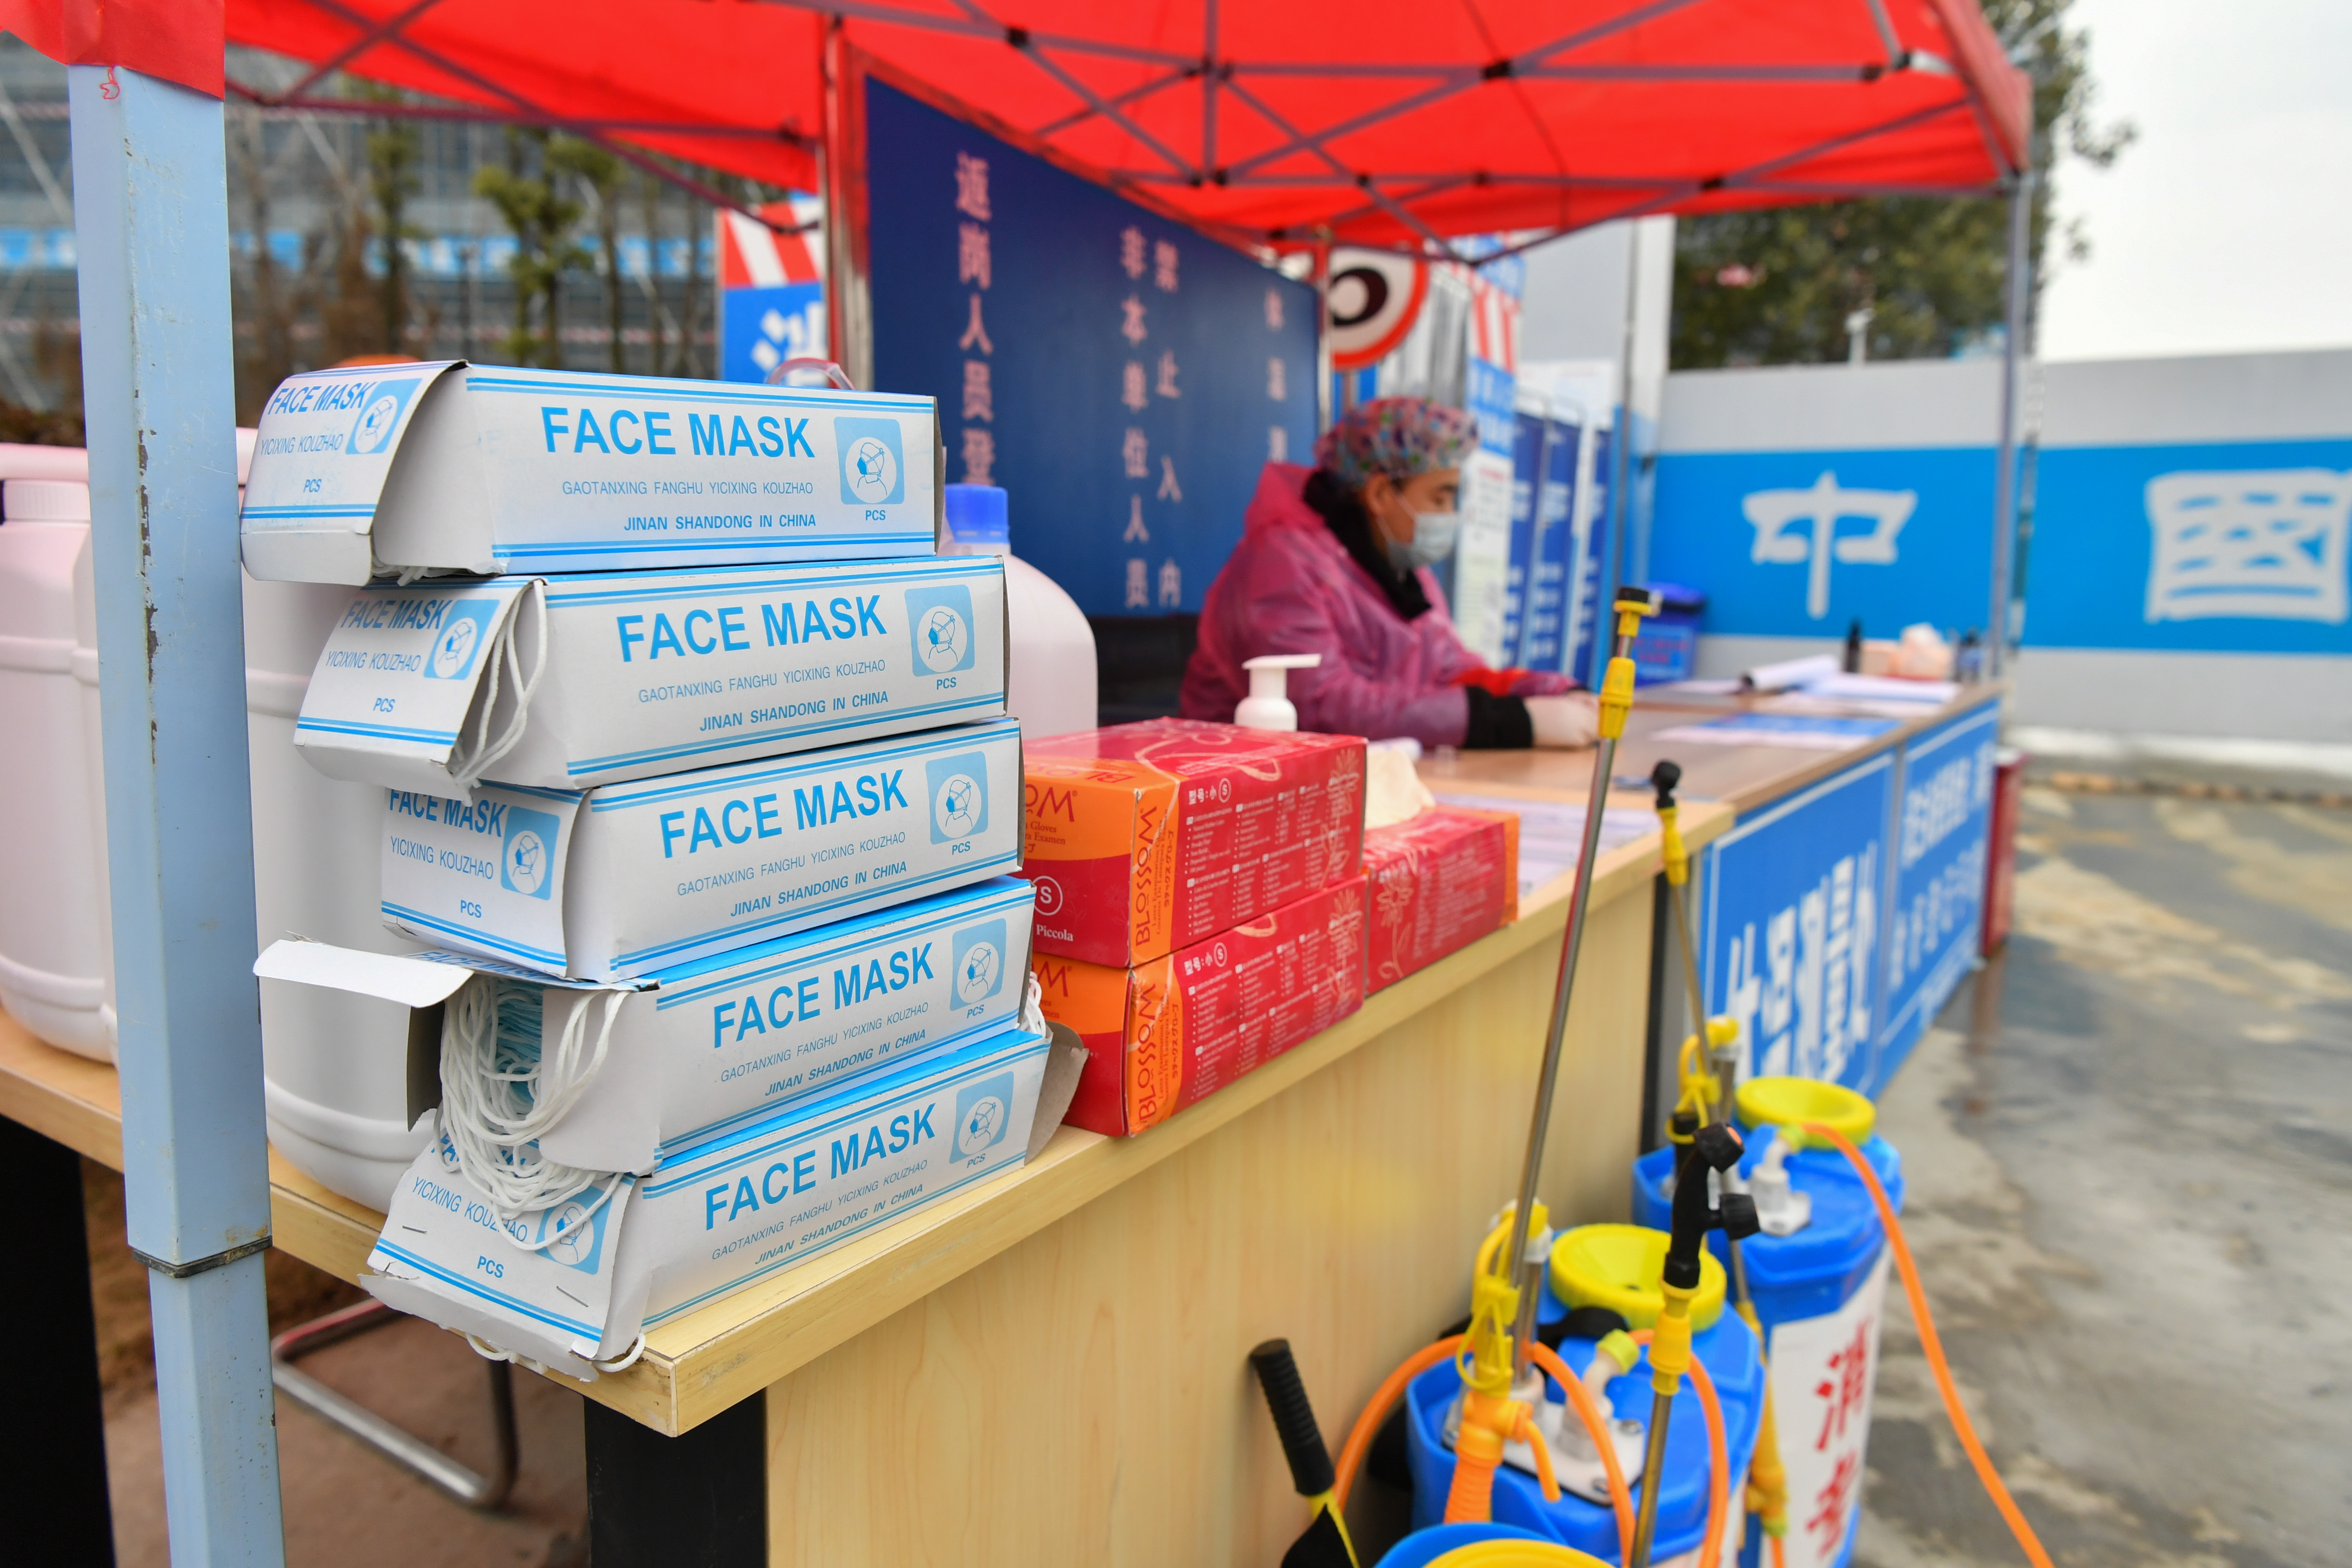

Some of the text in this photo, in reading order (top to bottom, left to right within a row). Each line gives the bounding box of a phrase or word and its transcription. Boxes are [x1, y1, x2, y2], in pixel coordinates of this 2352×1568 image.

[267, 382, 378, 415] FACE MASK
[261, 434, 343, 455] YICIXING KOUZHAO
[541, 406, 815, 458] FACE MASK
[303, 479, 322, 493] PCS
[562, 481, 813, 495] GAOTANXING FANGHU YICIXING KOUZHAO
[623, 514, 816, 531] JINAN SHANDONG IN CHINA
[865, 509, 886, 521] PCS
[340, 600, 453, 629] FACE MASK
[617, 595, 887, 662] FACE MASK
[326, 651, 421, 672] YICIXING KOUZHAO
[638, 659, 885, 704] GAOTANXING FANGHU YICIXING KOUZHAO
[936, 677, 957, 690] PCS
[373, 697, 395, 713] PCS
[700, 691, 889, 732] JINAN SHANDONG IN CHINA
[389, 789, 507, 838] FACE MASK
[659, 768, 909, 858] FACE MASK
[391, 836, 493, 879] YICIXING KOUZHAO
[677, 832, 906, 896] GAOTANXING FANGHU YICIXING KOUZHAO
[952, 841, 971, 855] PCS
[730, 861, 907, 917] JINAN SHANDONG IN CHINA
[1040, 886, 1052, 904] S
[460, 899, 482, 918] PCS
[1036, 924, 1074, 942] Piccola
[714, 942, 934, 1048] FACE MASK
[966, 1004, 984, 1018] PCS
[721, 1002, 929, 1082] GAOTANXING FANGHU YICIXING KOUZHAO
[765, 1029, 926, 1096] JINAN SHANDONG IN CHINA
[706, 1103, 936, 1230] FACE MASK
[966, 1153, 985, 1168] PCS
[412, 1176, 461, 1213] YICIXING
[712, 1160, 928, 1260] GAOTANXING FANGHU YICIXING KOUZHAO
[755, 1184, 923, 1265] JINAN SHANDONG IN CHINA
[477, 1255, 504, 1279] PCS
